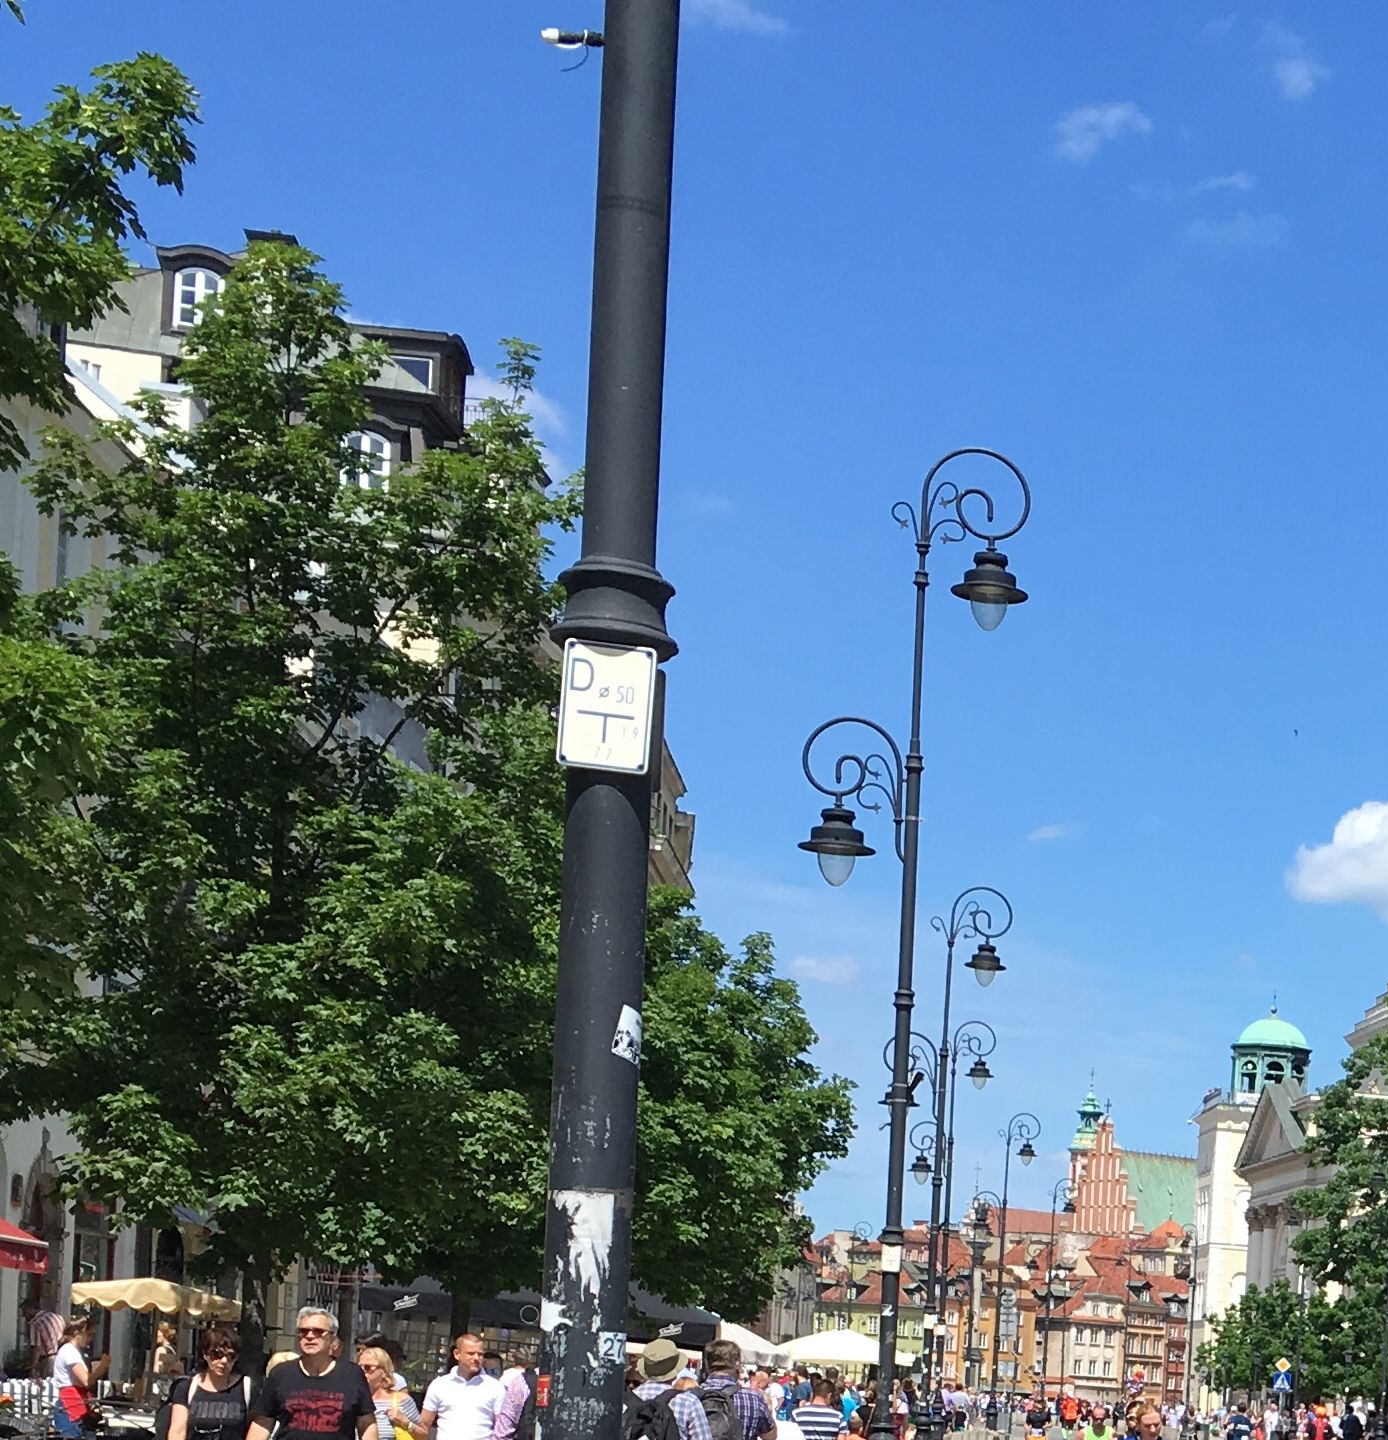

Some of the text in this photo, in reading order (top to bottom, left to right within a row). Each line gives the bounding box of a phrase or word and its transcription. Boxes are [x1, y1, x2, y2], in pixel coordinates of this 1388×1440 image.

[570, 657, 595, 692] D
[615, 685, 635, 705] 50
[603, 1337, 624, 1359] 27
